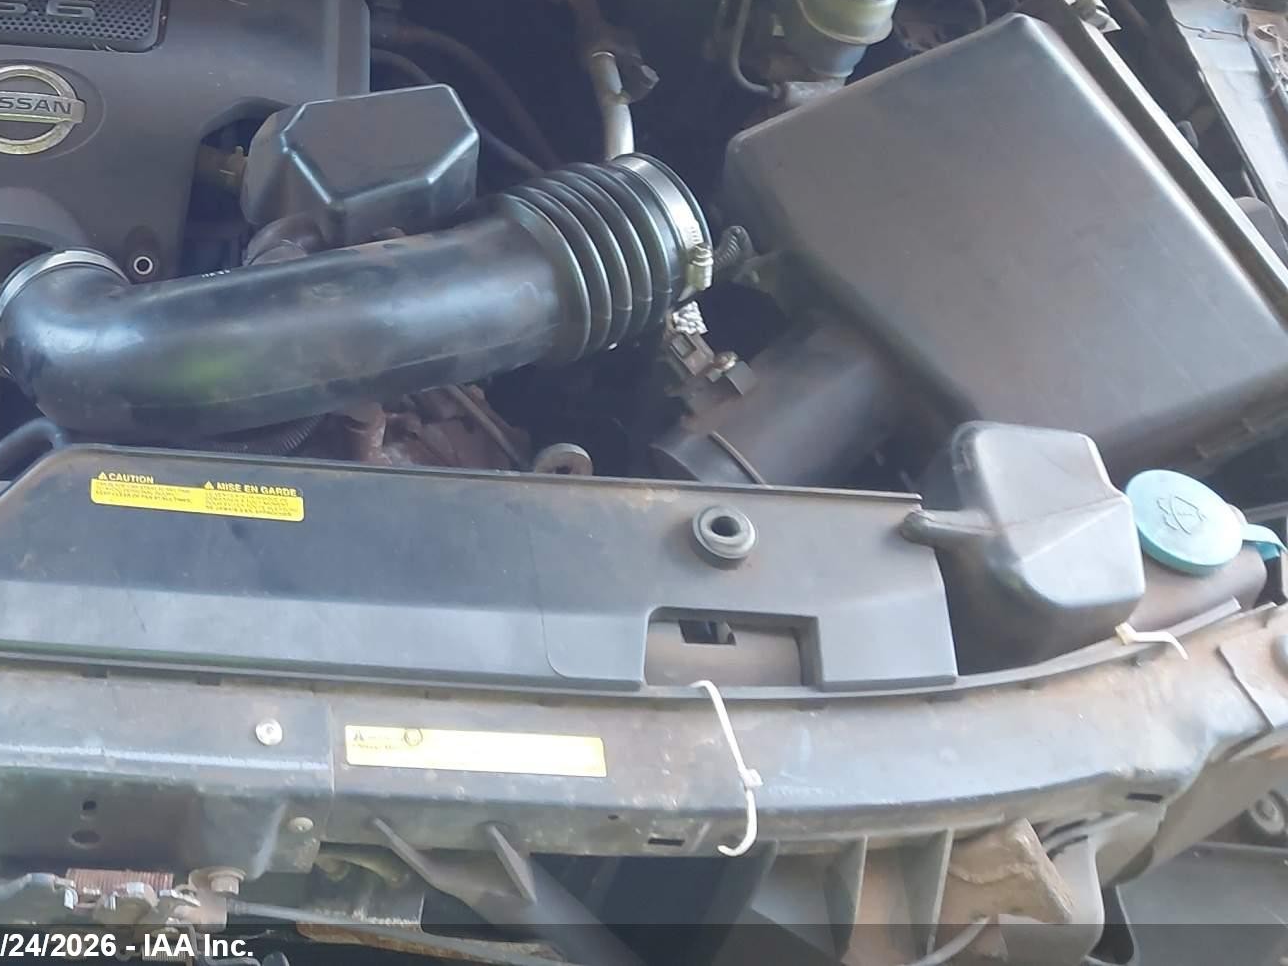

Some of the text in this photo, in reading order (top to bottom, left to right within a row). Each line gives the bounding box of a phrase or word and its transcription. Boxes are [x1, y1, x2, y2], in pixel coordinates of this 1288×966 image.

[108, 472, 154, 484] CAUTION
[216, 481, 297, 498] MISE EN GARDE
